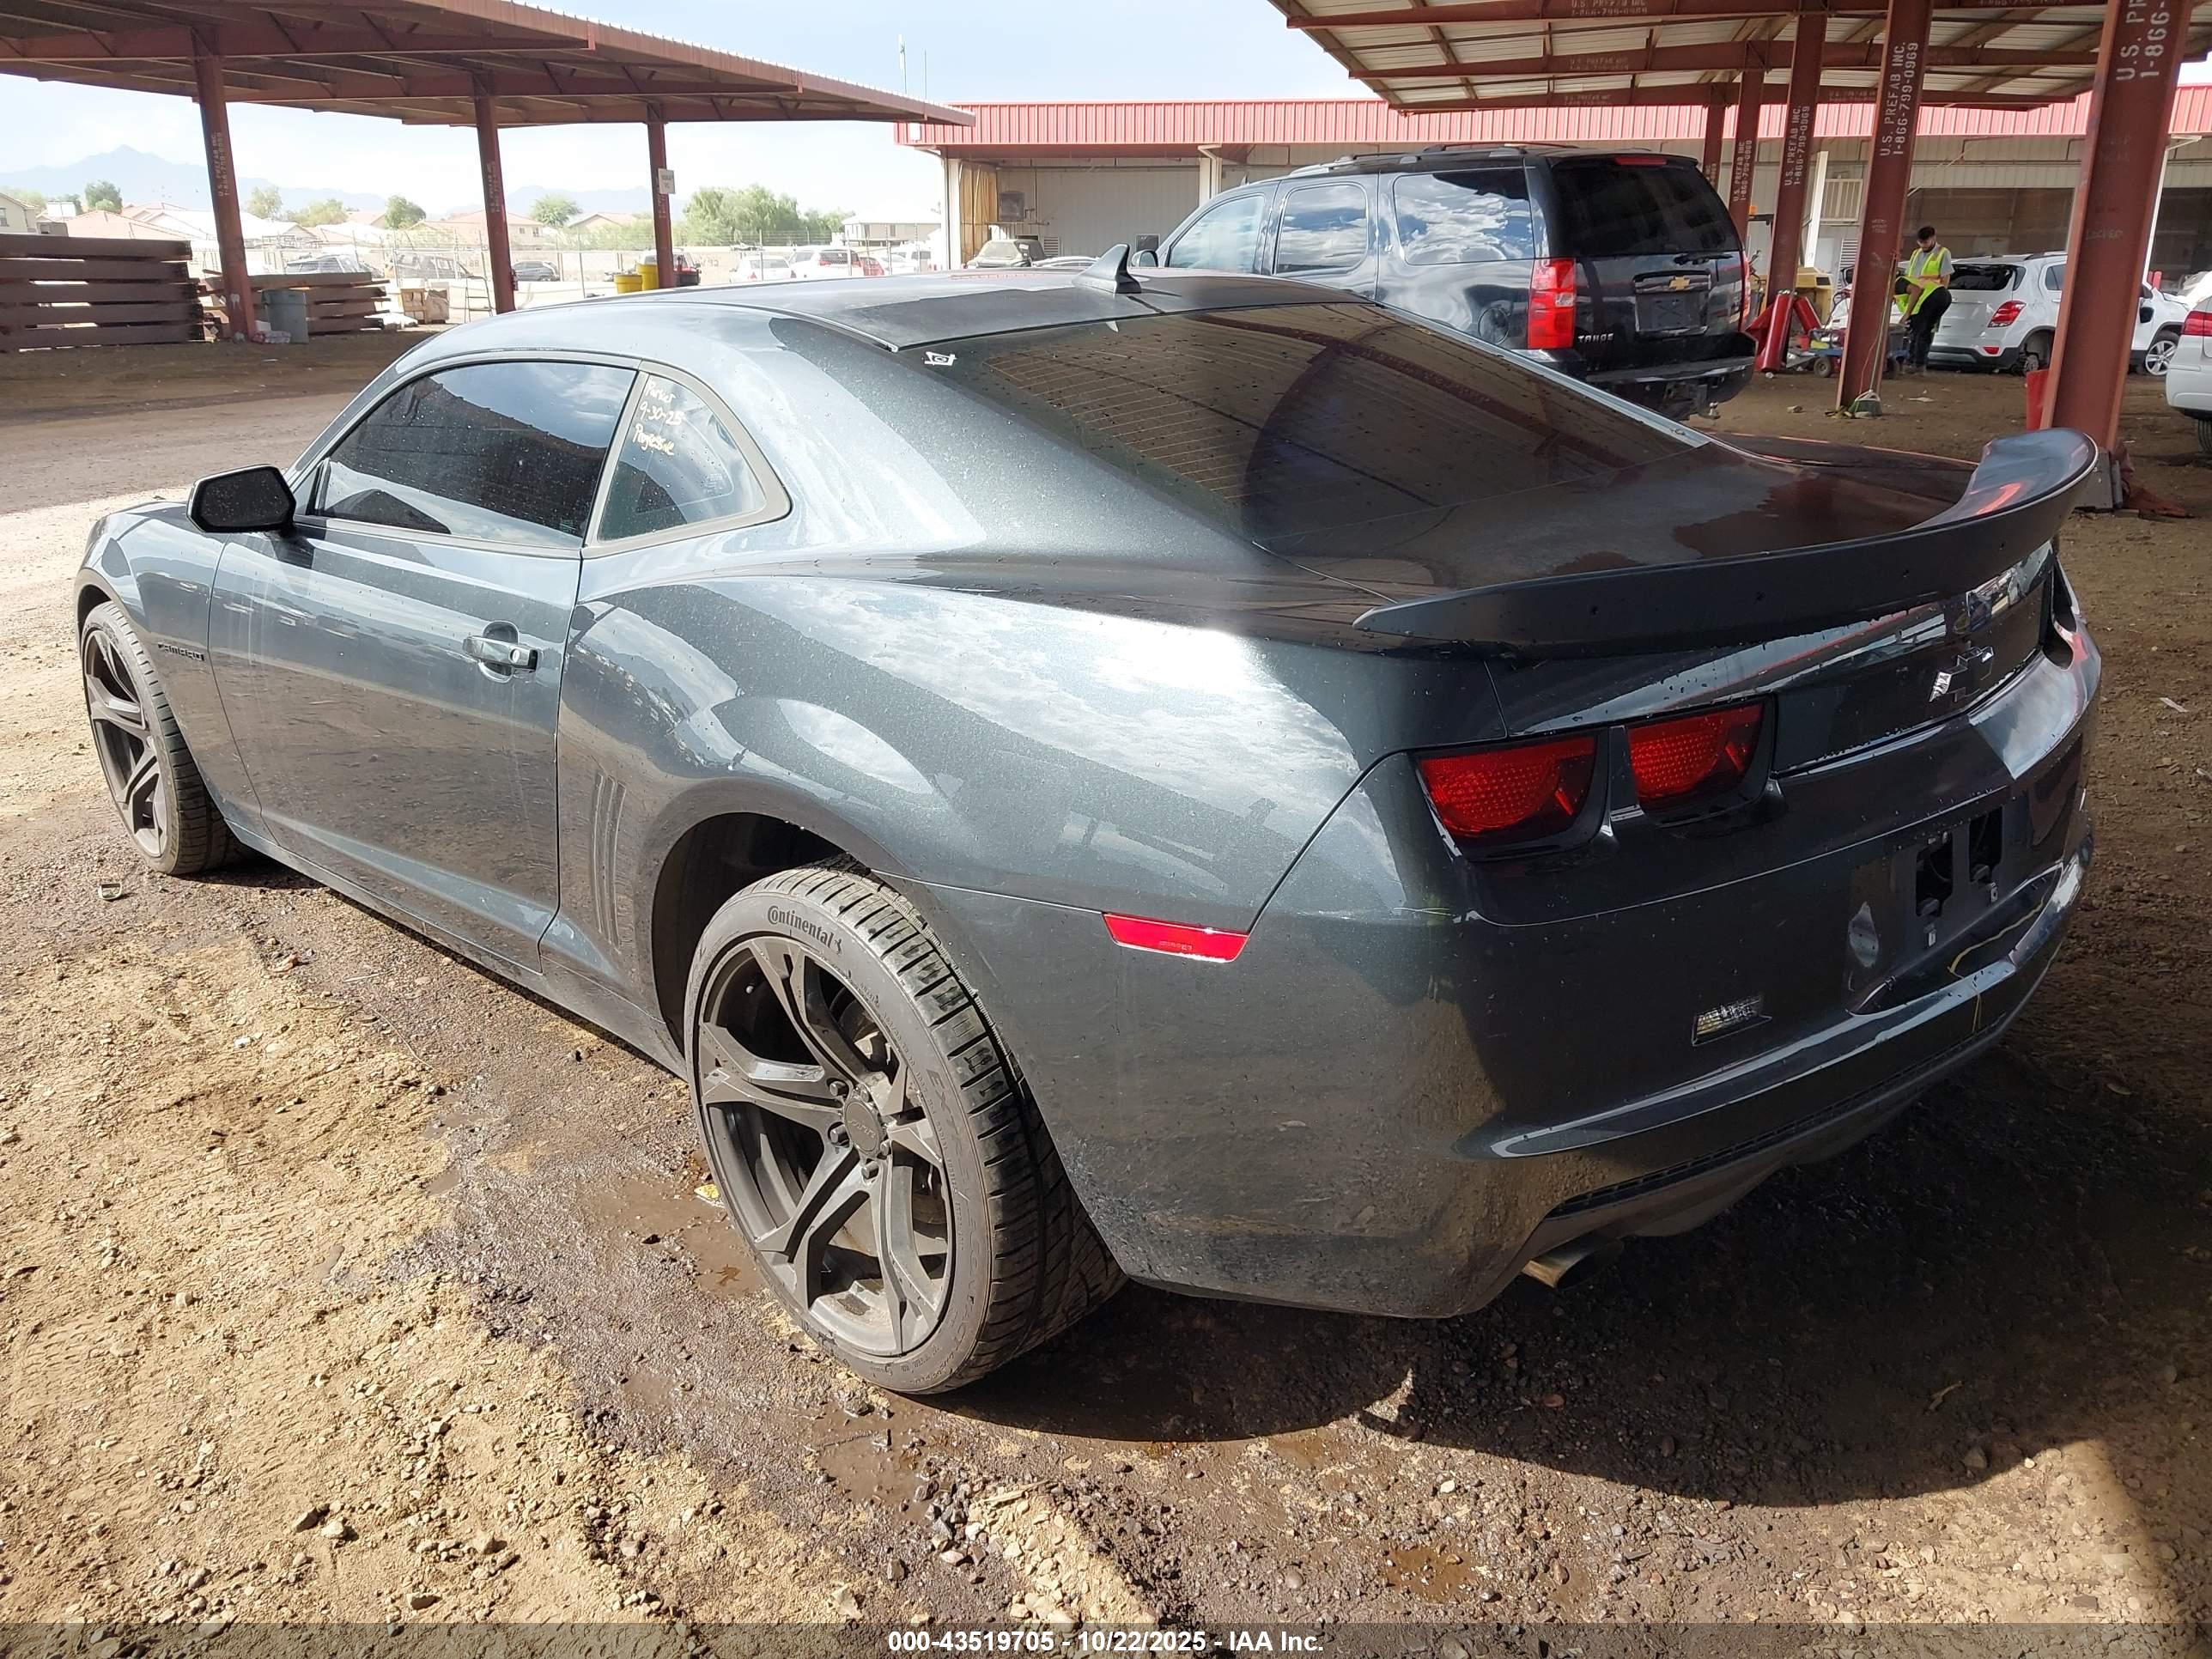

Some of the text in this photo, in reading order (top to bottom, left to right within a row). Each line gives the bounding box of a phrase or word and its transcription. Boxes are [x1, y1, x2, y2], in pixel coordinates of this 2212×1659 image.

[2116, 40, 2142, 80] U.S.
[1880, 42, 1905, 156] U.S. PREFAB INC.
[1893, 42, 1919, 155] 1-866-799-0969
[1787, 128, 1799, 164] PREFAB
[1577, 332, 1614, 343] TAHOE
[640, 401, 685, 426] 9-30-25
[157, 641, 205, 661] CAMARO
[767, 905, 835, 948] Continental
